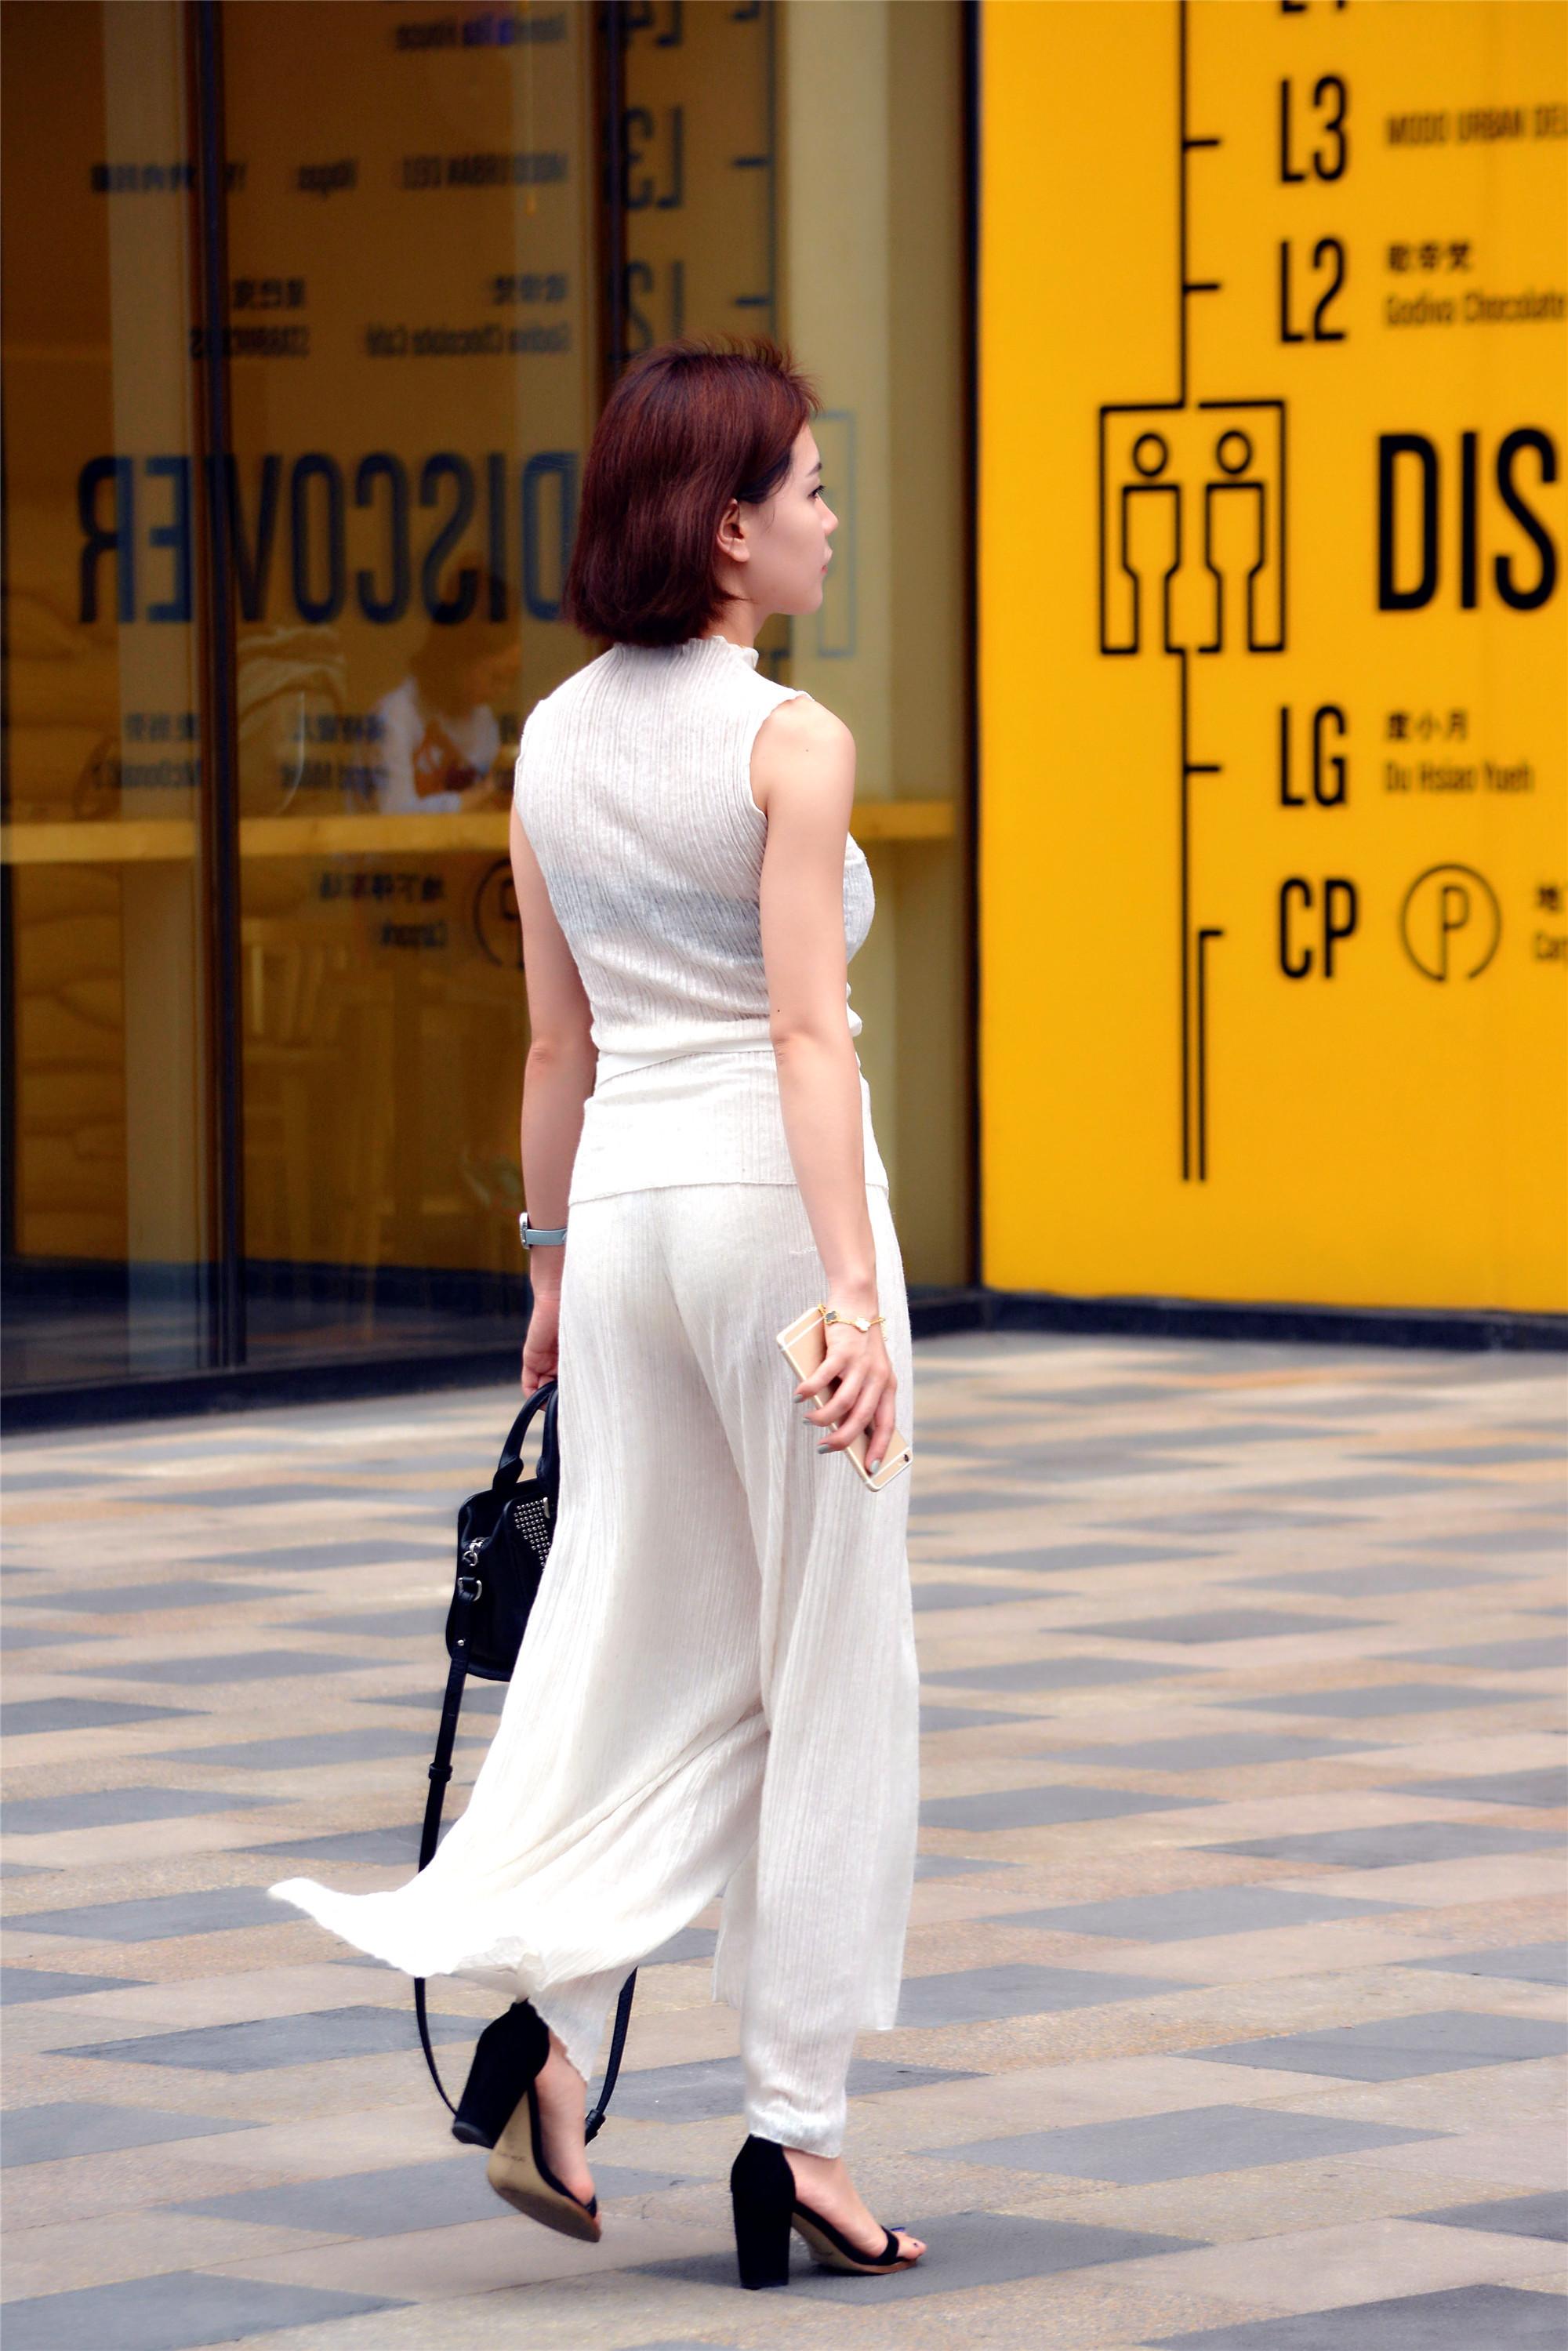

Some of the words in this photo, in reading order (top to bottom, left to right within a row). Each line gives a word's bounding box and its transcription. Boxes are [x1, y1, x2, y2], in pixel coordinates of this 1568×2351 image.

[1279, 74, 1348, 183] L3
[1279, 237, 1347, 343] L2
[1377, 427, 1559, 612] DIS
[1279, 705, 1347, 808] LG
[1279, 877, 1358, 979] CP
